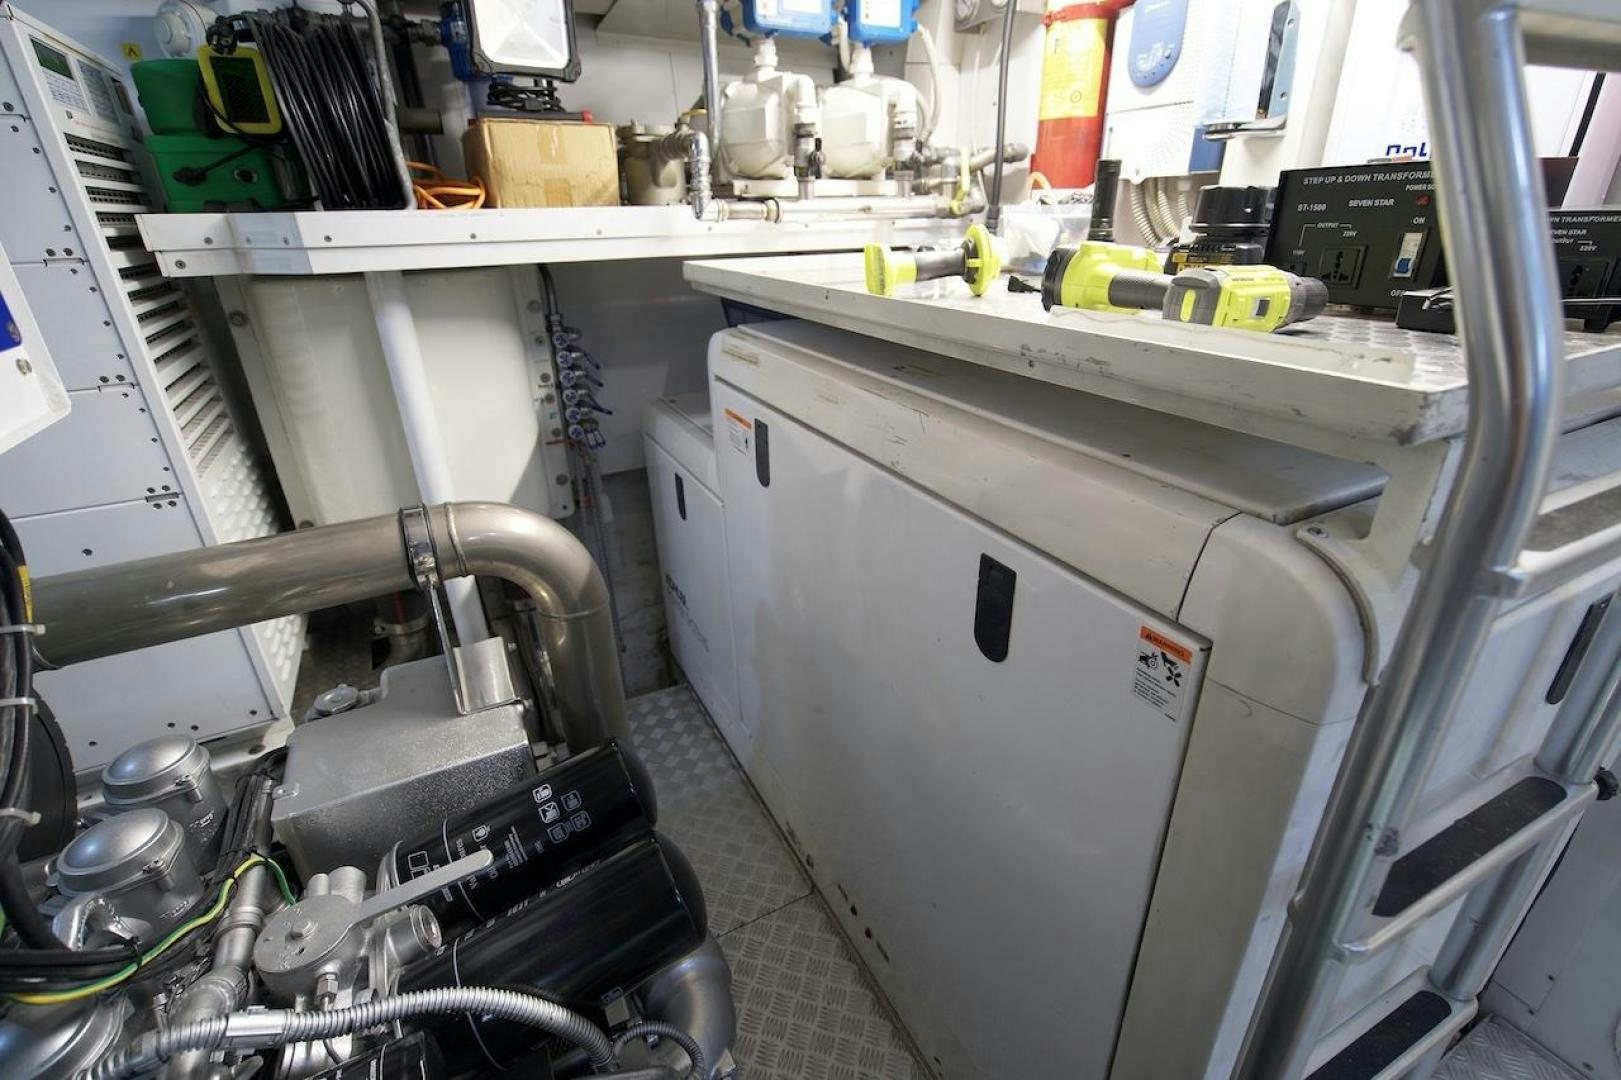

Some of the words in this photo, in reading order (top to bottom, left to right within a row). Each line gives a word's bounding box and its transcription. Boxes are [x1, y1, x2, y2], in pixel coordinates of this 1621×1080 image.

[1303, 177, 1323, 185] STEP
[1325, 176, 1337, 184] UP
[1344, 174, 1371, 183] DOWN
[1373, 171, 1433, 181] TRANSFORM
